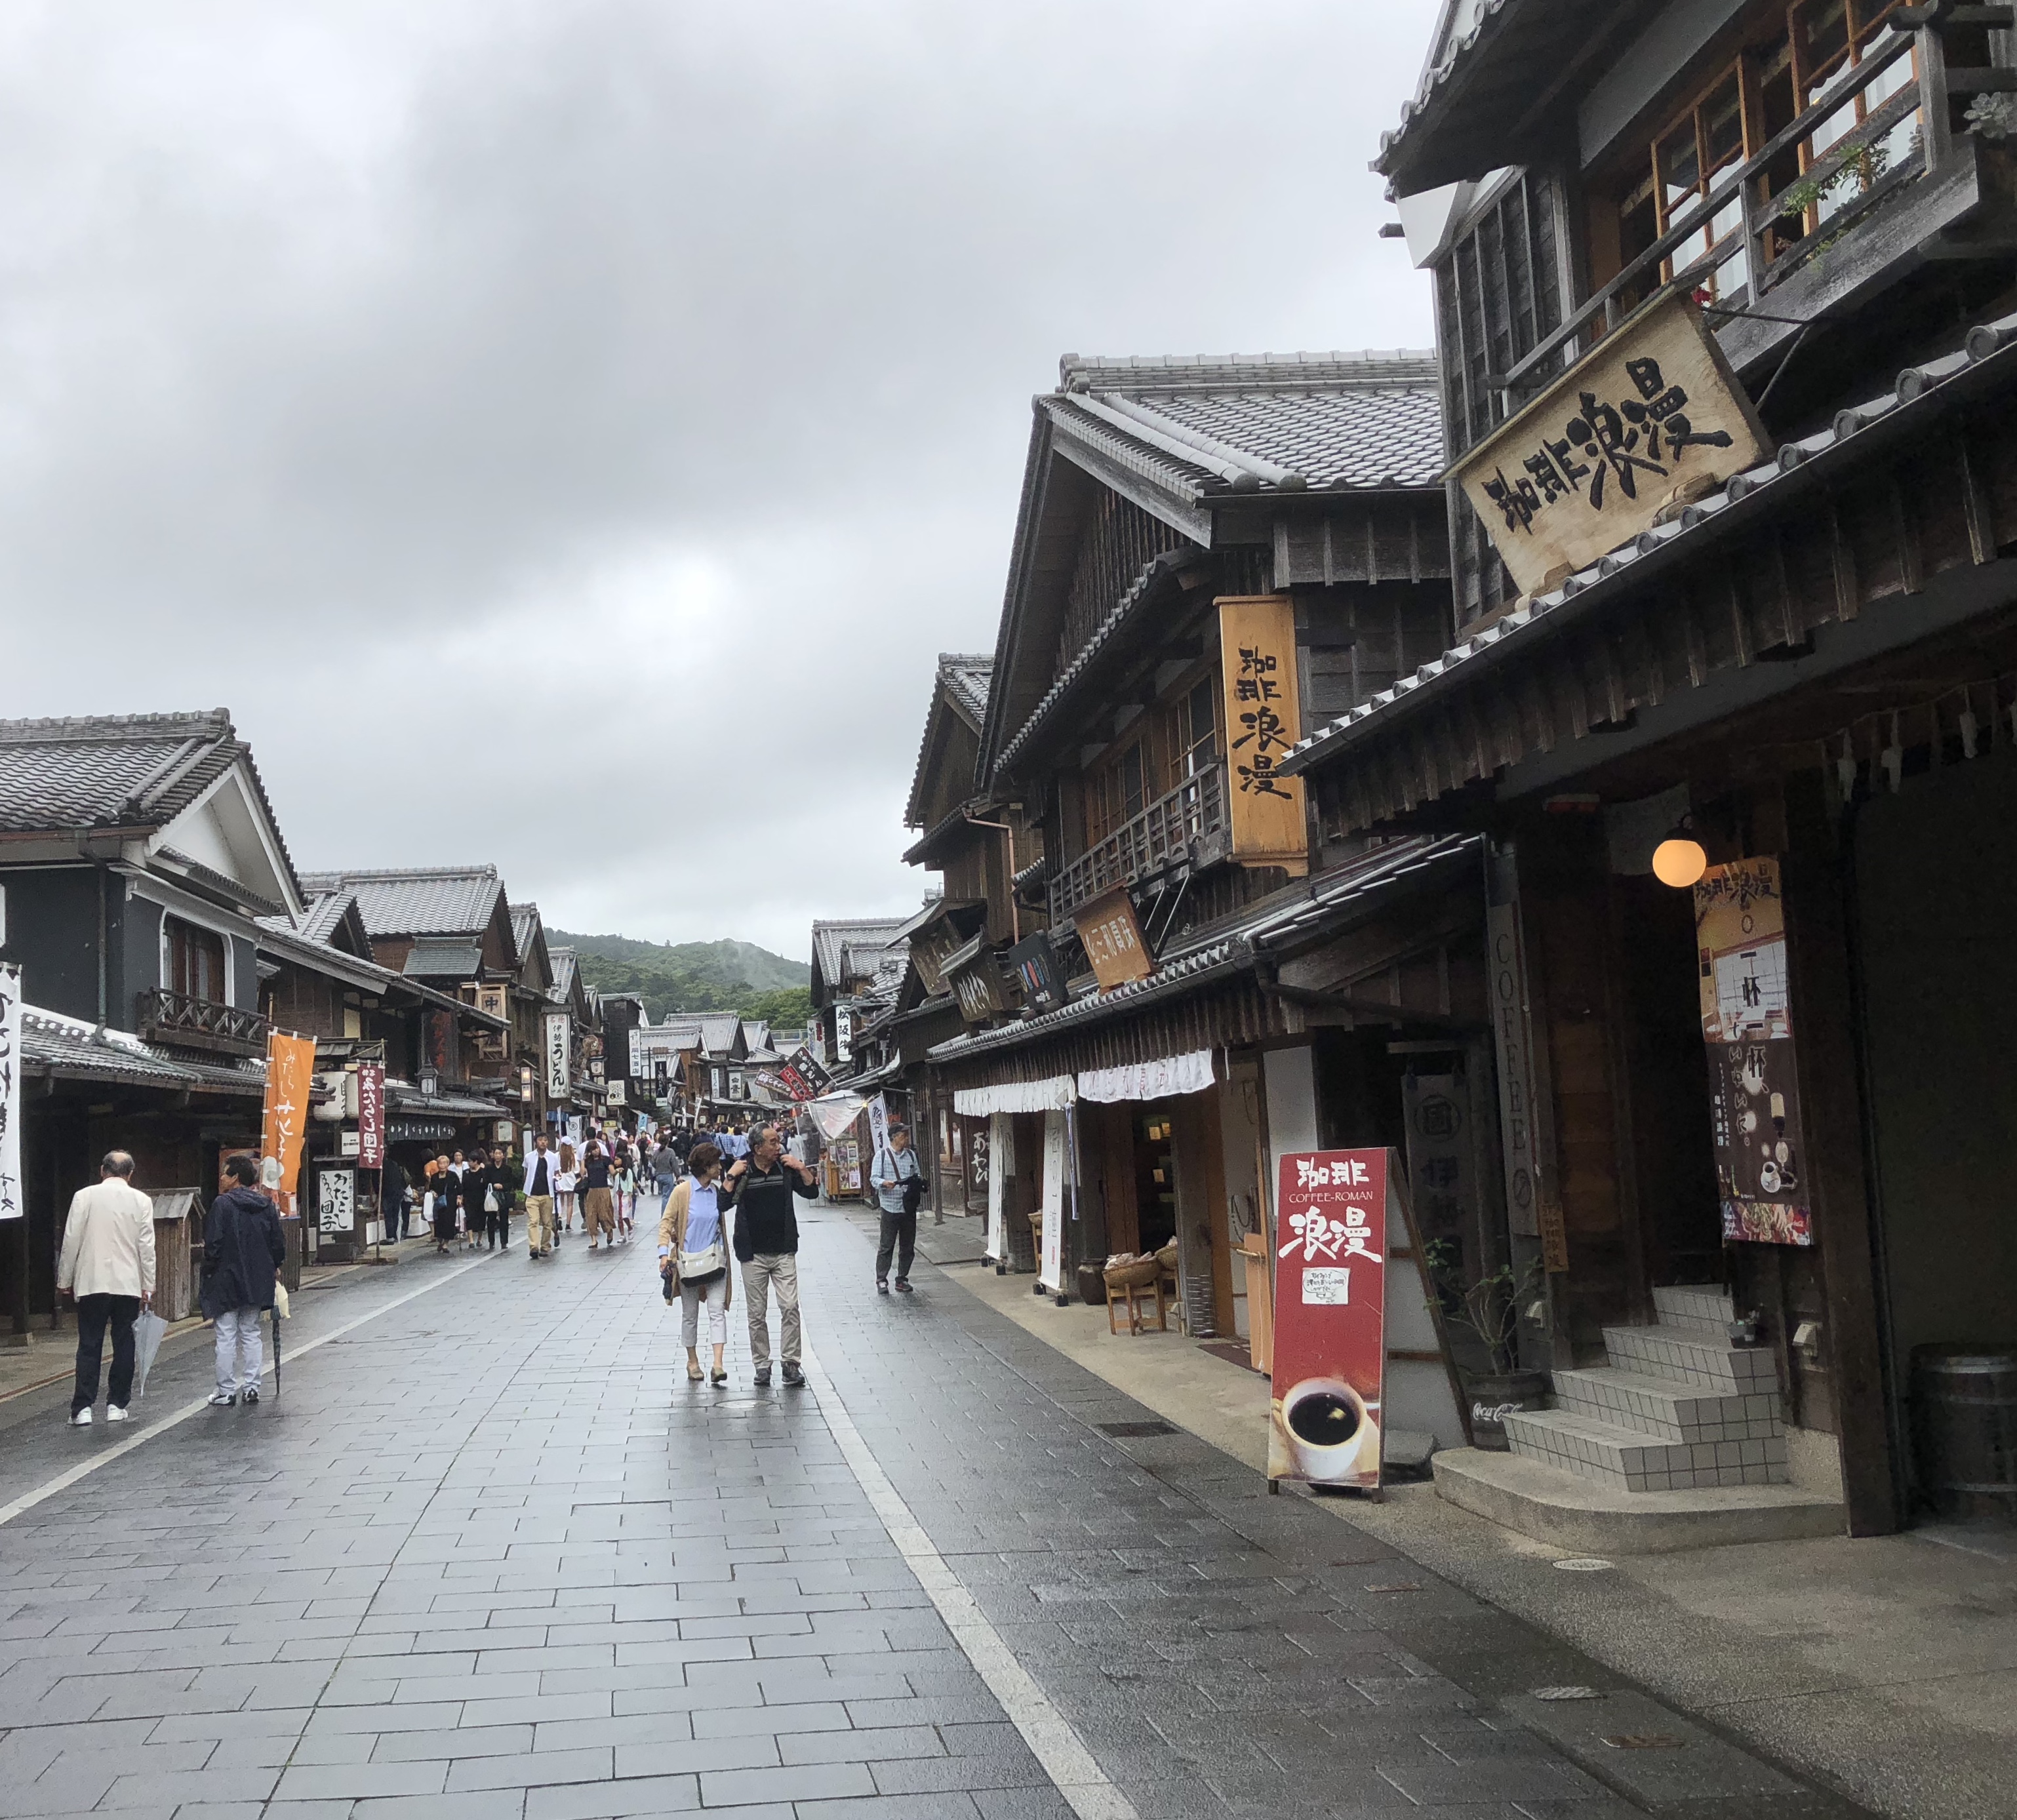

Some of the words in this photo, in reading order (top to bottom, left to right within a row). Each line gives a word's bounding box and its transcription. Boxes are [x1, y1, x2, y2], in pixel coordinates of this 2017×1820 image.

[1482, 357, 1732, 534] 珈琲浪漫
[1233, 646, 1292, 800] 珈琲浪漫
[553, 1025, 565, 1086] 伊勢うどん
[837, 1010, 850, 1050] 松阪牛
[1497, 934, 1527, 1151] COFFEE
[971, 1131, 988, 1183] あわび
[1297, 1157, 1369, 1191] 珈琲
[320, 1199, 337, 1230] 団子
[333, 1173, 349, 1229] みたらし
[1288, 1191, 1373, 1204] COFFEE-ROMAN
[1278, 1206, 1382, 1262] 浪漫
